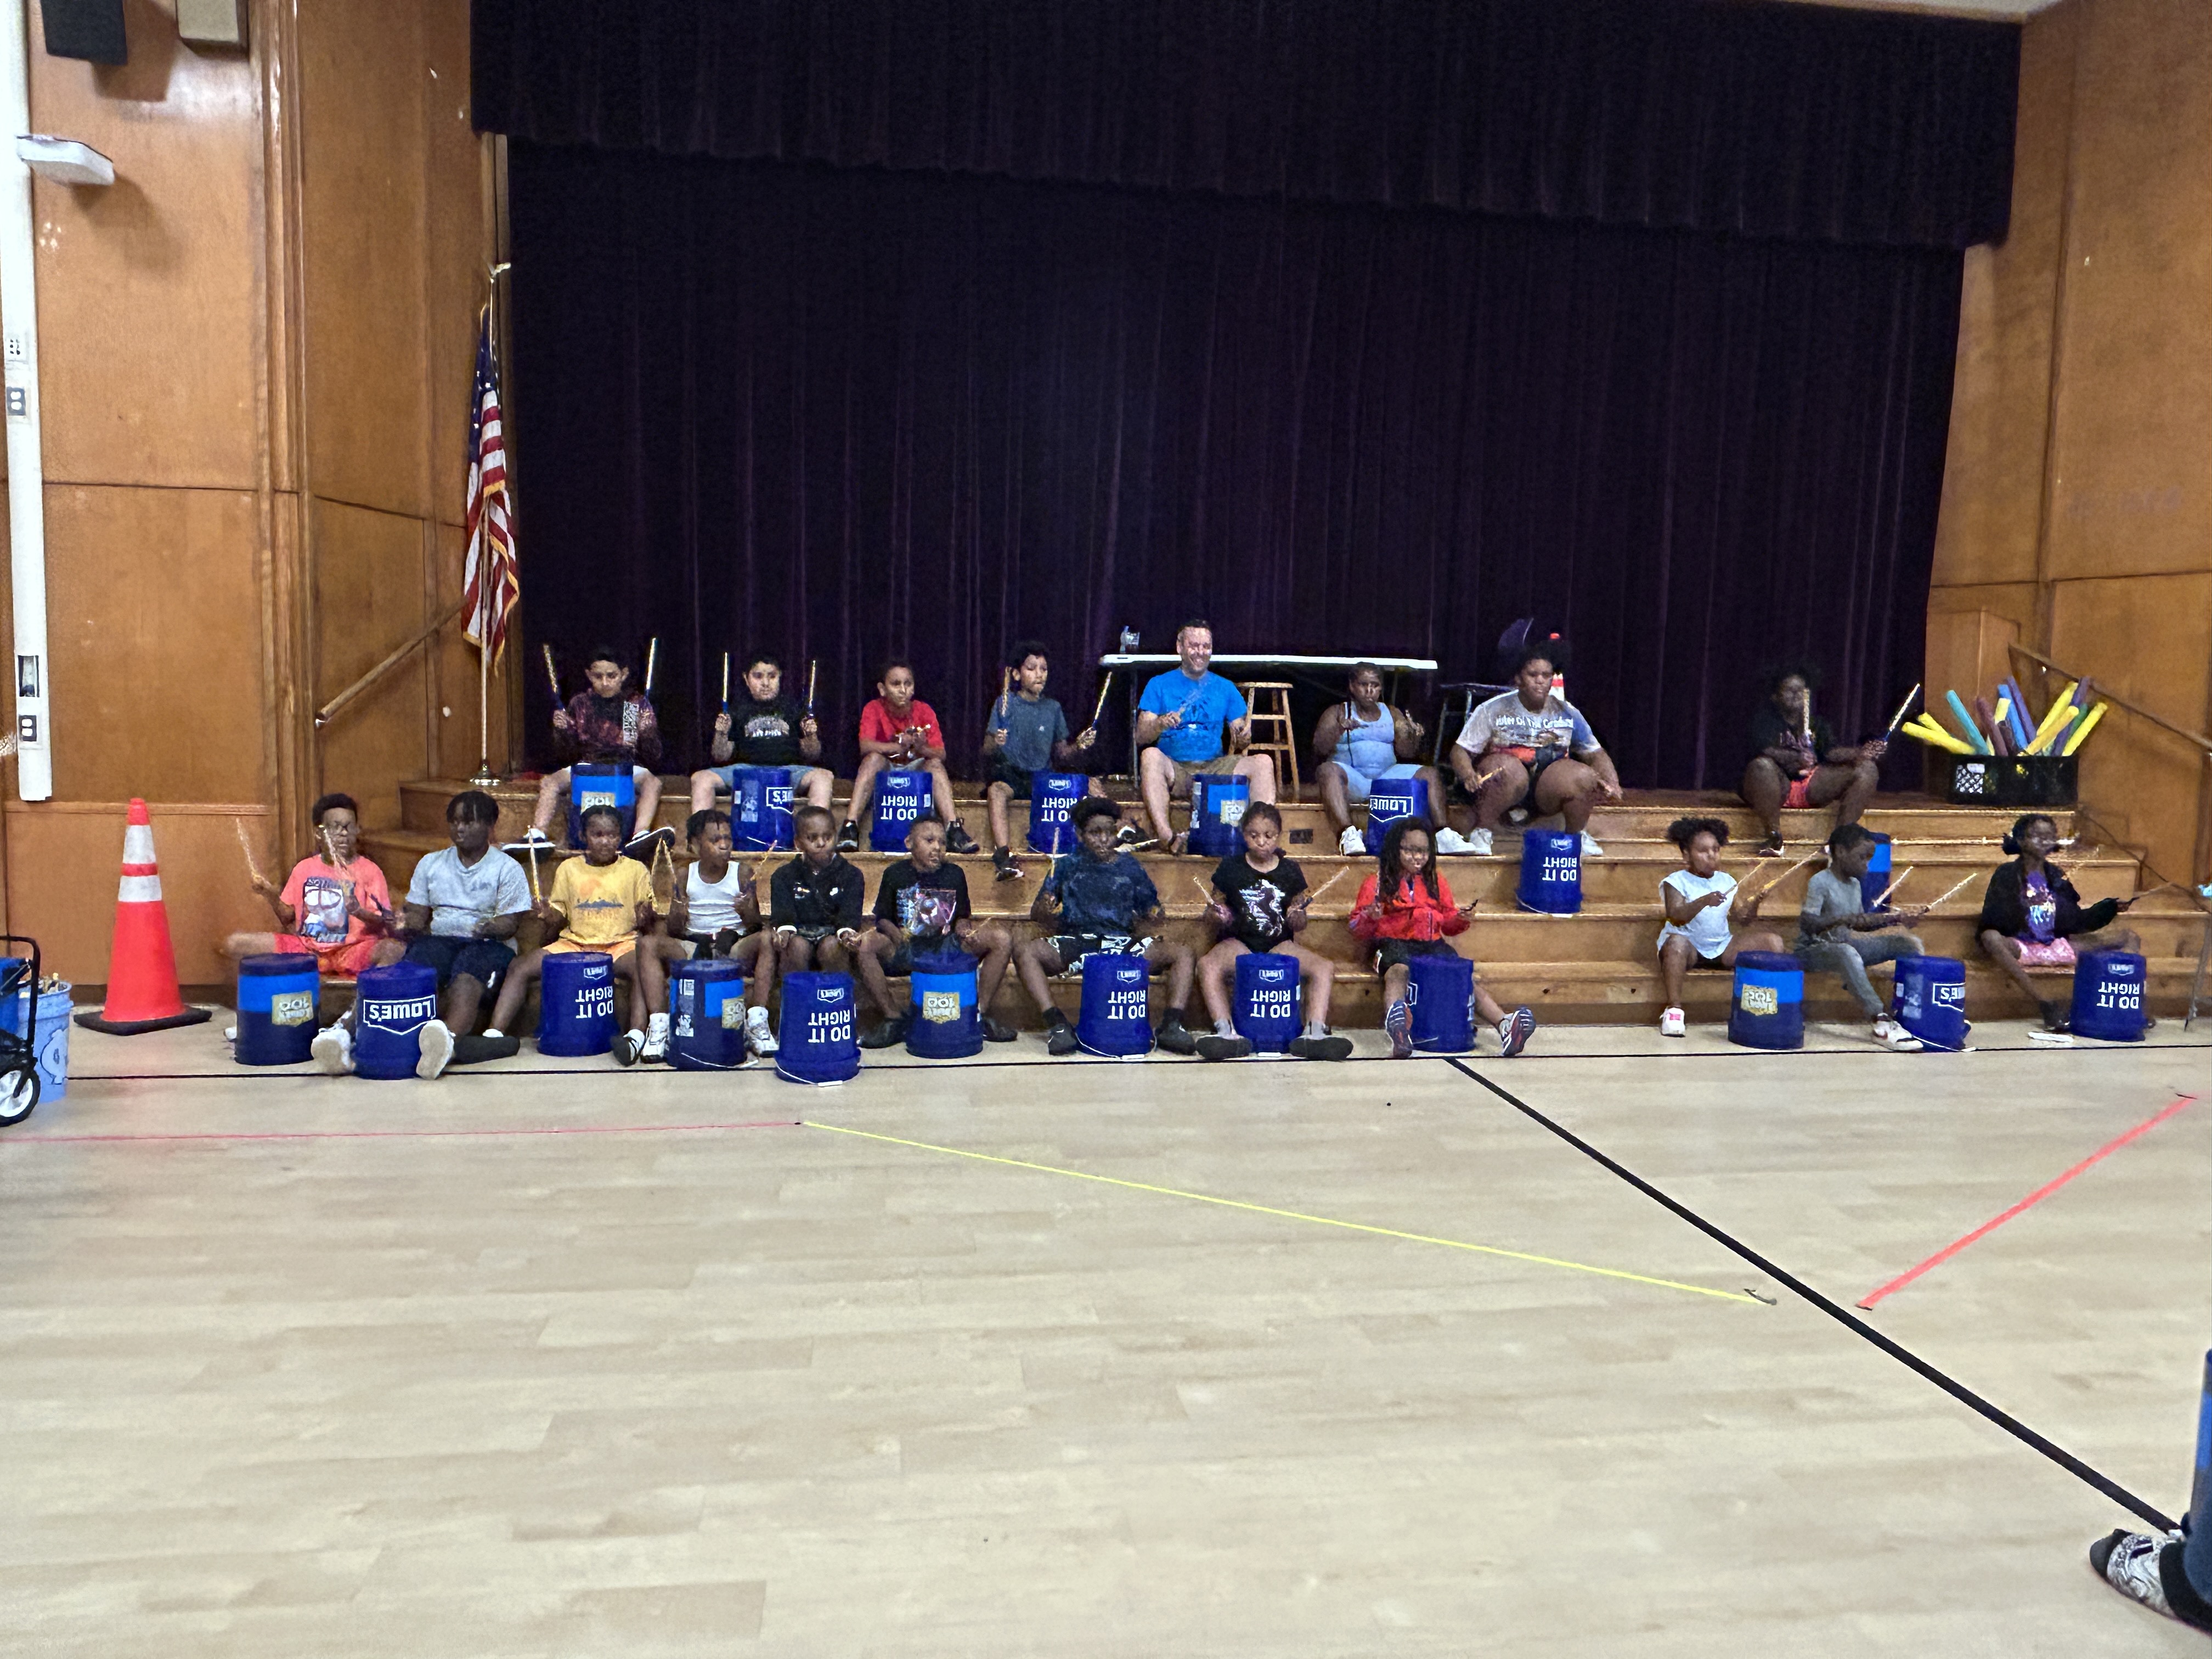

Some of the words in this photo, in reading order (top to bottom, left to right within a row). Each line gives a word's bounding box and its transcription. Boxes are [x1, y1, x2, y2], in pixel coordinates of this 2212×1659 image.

[881, 795, 917, 806] RIGHT
[881, 808, 893, 820] IT
[897, 809, 917, 821] DO
[1041, 810, 1053, 822] IT
[1058, 810, 1070, 822] O
[1543, 857, 1577, 867] RIGHT
[1542, 868, 1556, 881] IT
[1560, 870, 1576, 881] DO
[575, 986, 613, 1002] RIGHT
[2098, 981, 2140, 994] RIGHT
[1108, 990, 1146, 1003] RIGHT
[1251, 990, 1291, 1002] RIGHT
[2097, 995, 2114, 1008] IT
[2119, 996, 2139, 1009] DO
[369, 1000, 431, 1022] LOWE'S
[576, 1004, 591, 1018] IT
[597, 1000, 613, 1017] DO
[1108, 1006, 1123, 1019] IT
[1128, 1005, 1146, 1019] DO
[1250, 1003, 1265, 1018] IT
[1270, 1004, 1291, 1018] DO
[808, 1010, 850, 1026] RIGHT
[808, 1028, 825, 1043] IT
[831, 1025, 850, 1041] DO
